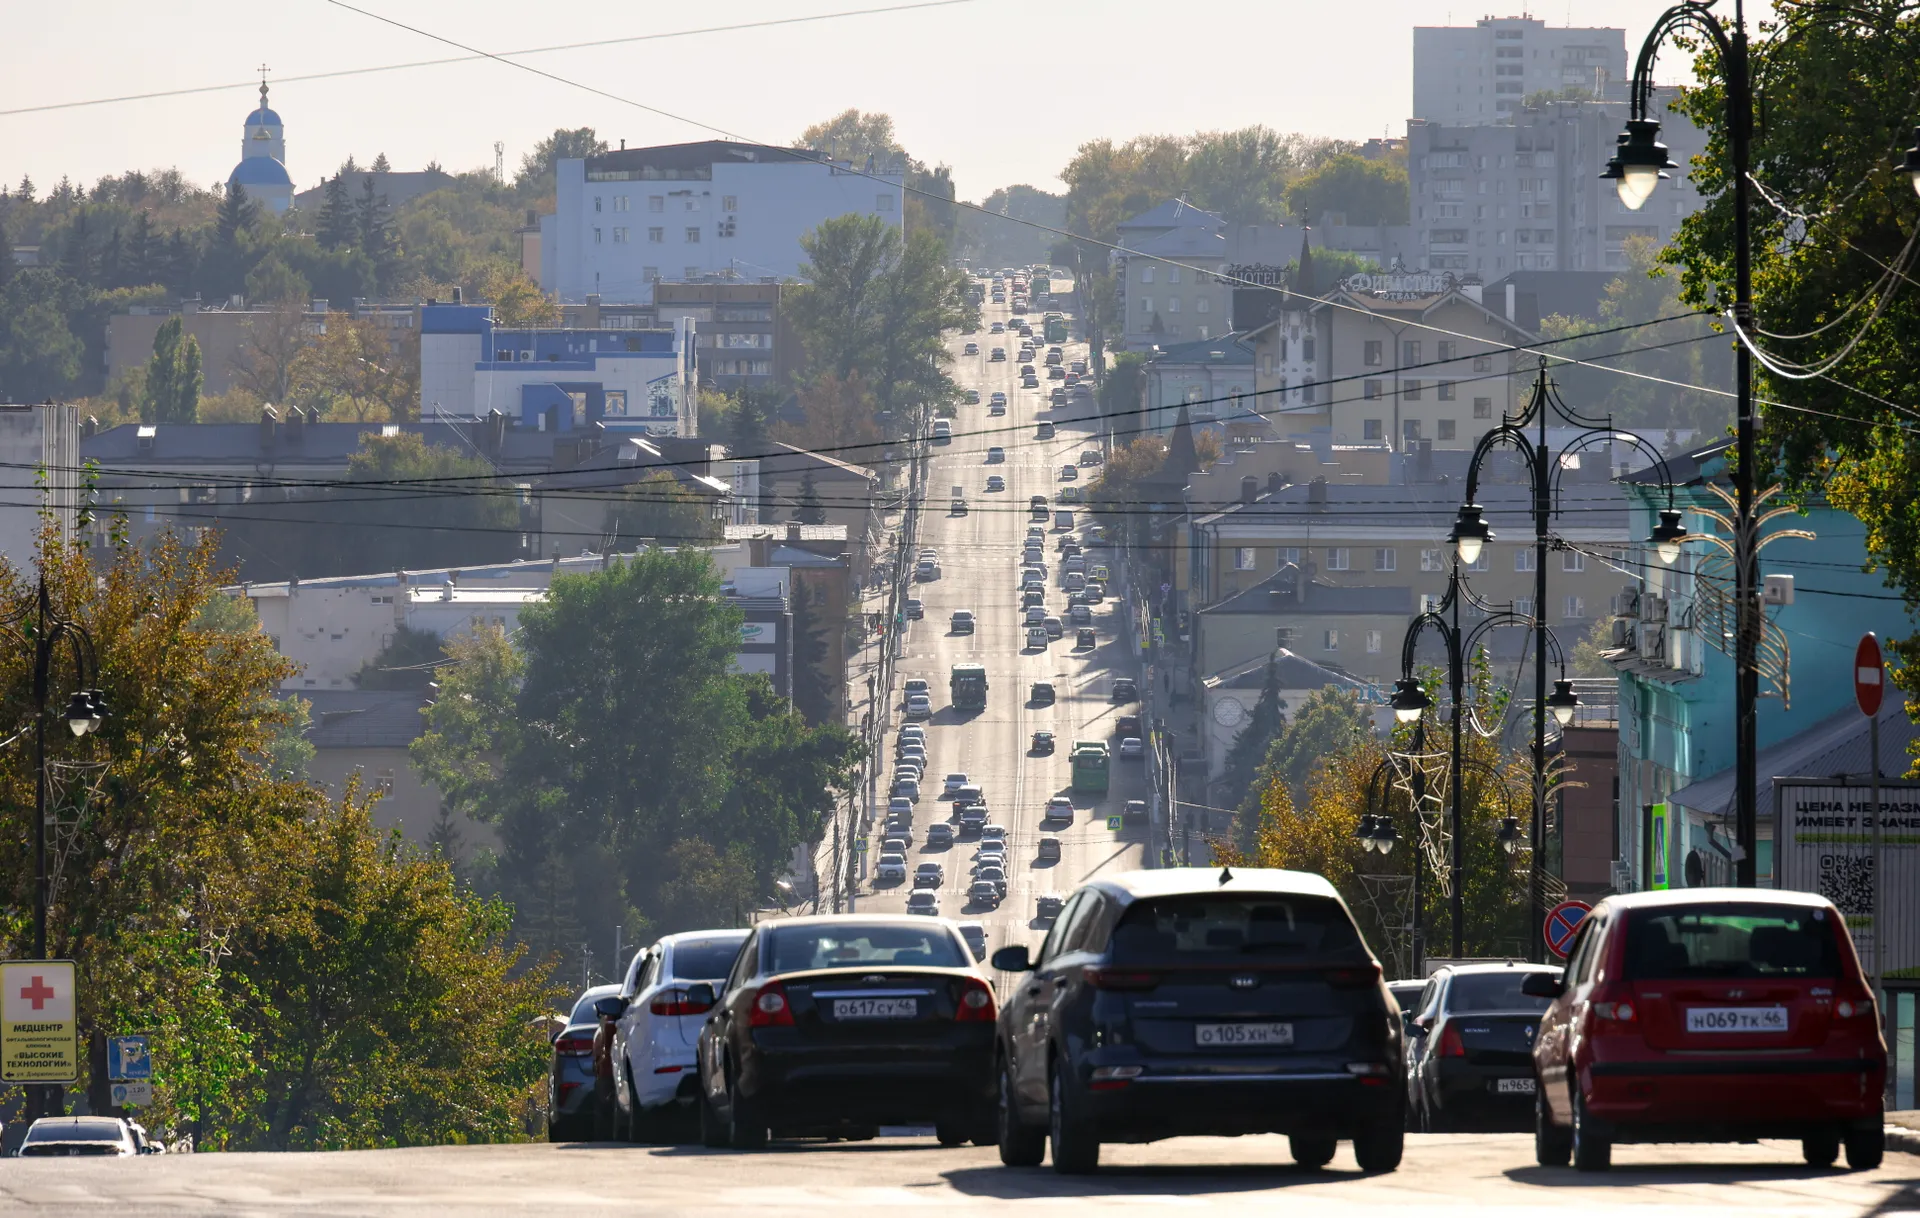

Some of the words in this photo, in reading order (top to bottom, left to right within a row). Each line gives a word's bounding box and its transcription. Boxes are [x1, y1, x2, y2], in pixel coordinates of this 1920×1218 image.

[1234, 271, 1280, 285] HOTEL
[1348, 272, 1443, 292] ДИНАСТИЯ
[1382, 292, 1417, 300] ОТЕЛЬ
[1796, 801, 1844, 814] ЦЕНА
[1849, 802, 1873, 813] НЕ
[1795, 816, 1857, 828] ИМЕЕТ
[13, 1023, 63, 1033] МЕДЦЕНТР
[14, 1051, 64, 1059] «ВЫСОКИЕ
[7, 1060, 72, 1068] ТЕХНОЛОГИИ»
